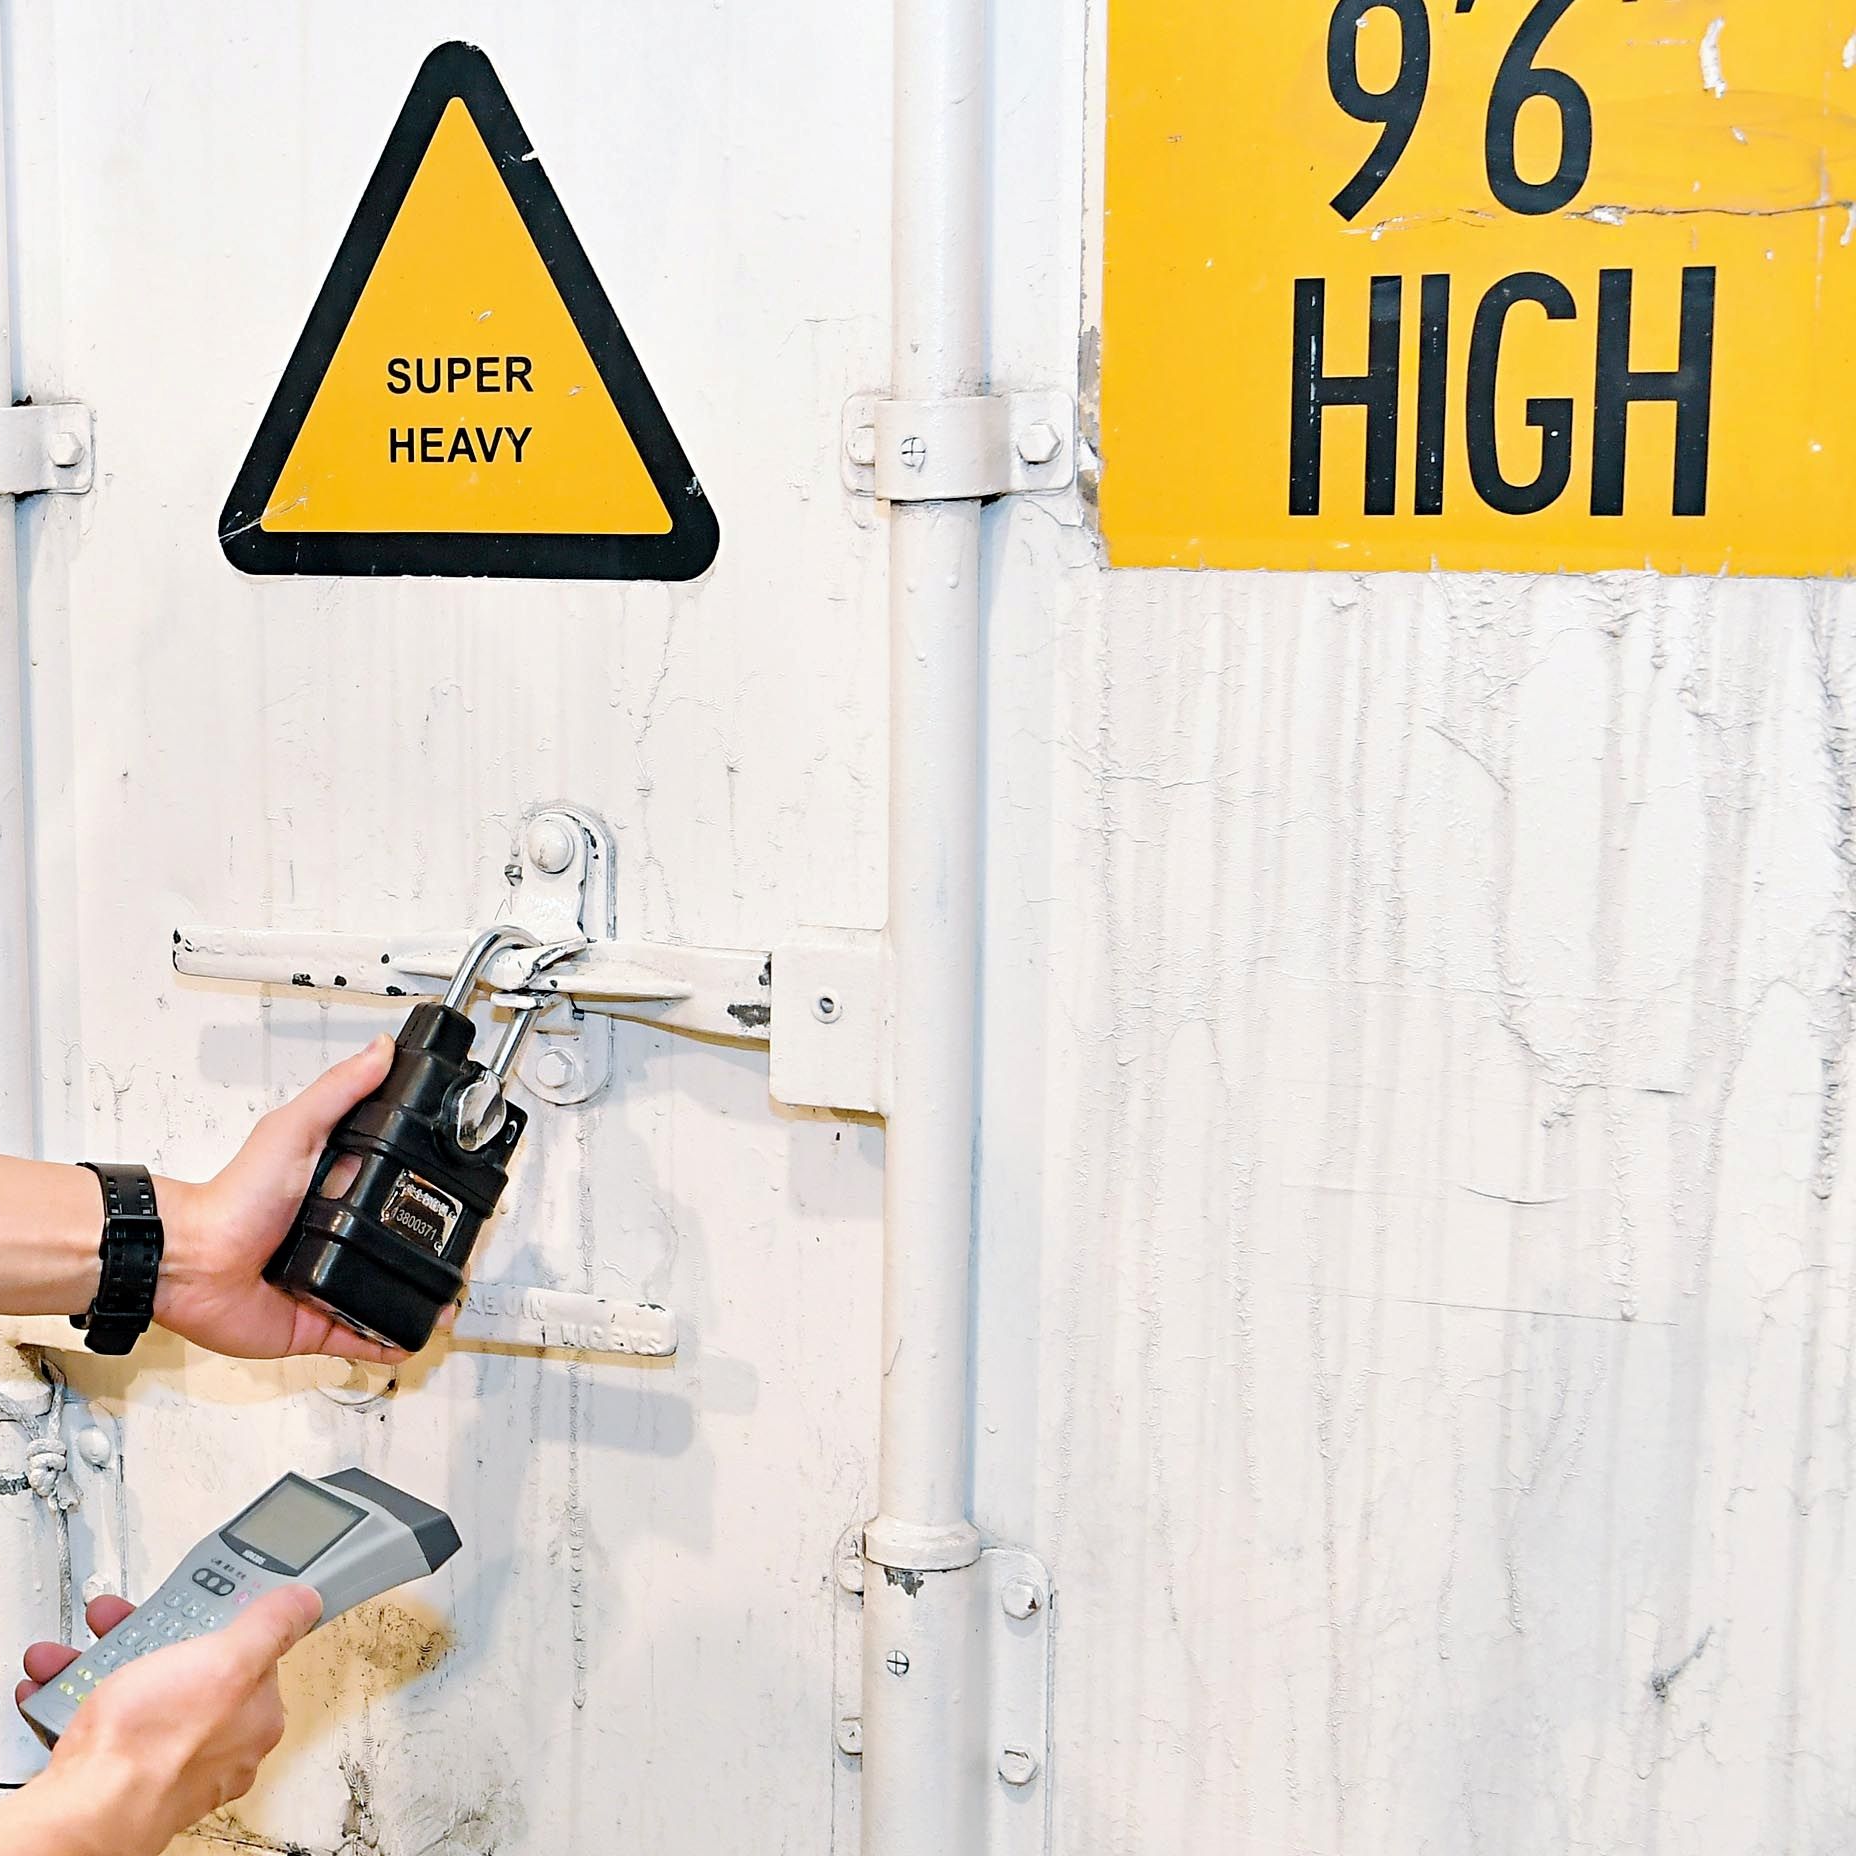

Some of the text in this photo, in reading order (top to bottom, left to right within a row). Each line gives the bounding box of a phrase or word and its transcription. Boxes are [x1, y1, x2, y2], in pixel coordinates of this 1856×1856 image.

[386, 356, 534, 394] SUPER
[1289, 266, 1716, 516] HIGH
[389, 427, 533, 463] HEAVY
[390, 1206, 438, 1241] 13800371
